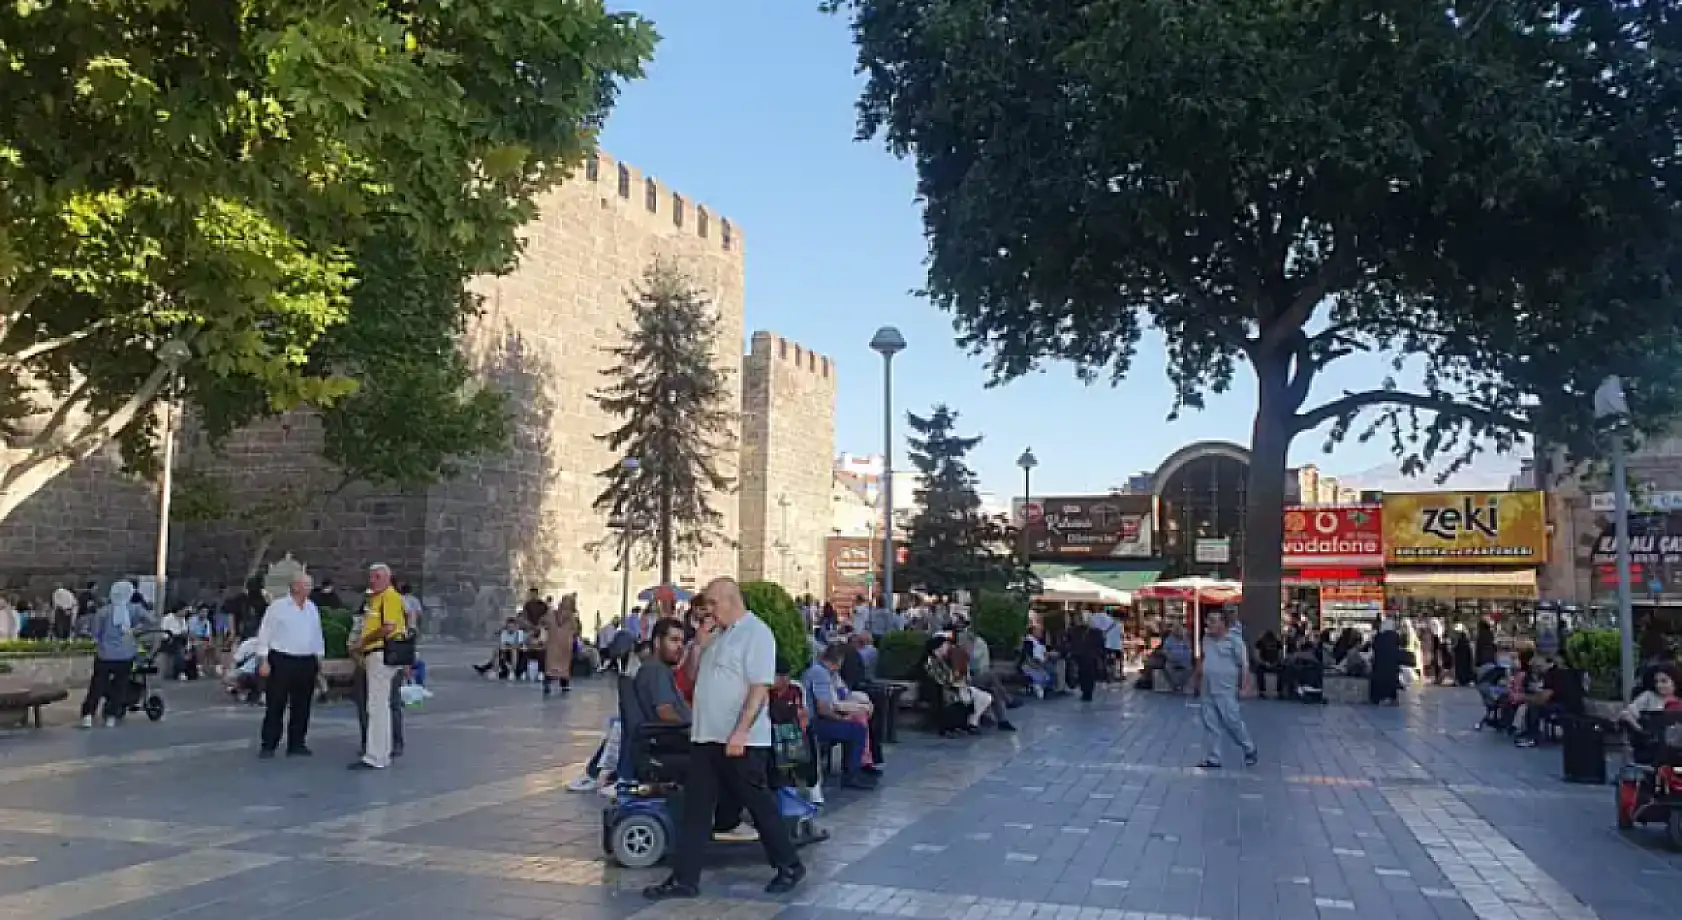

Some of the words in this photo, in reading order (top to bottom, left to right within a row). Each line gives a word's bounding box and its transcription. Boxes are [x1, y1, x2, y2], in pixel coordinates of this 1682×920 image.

[1422, 496, 1498, 540] zeki
[1283, 536, 1377, 552] vodafone
[1598, 536, 1655, 552] KALI
